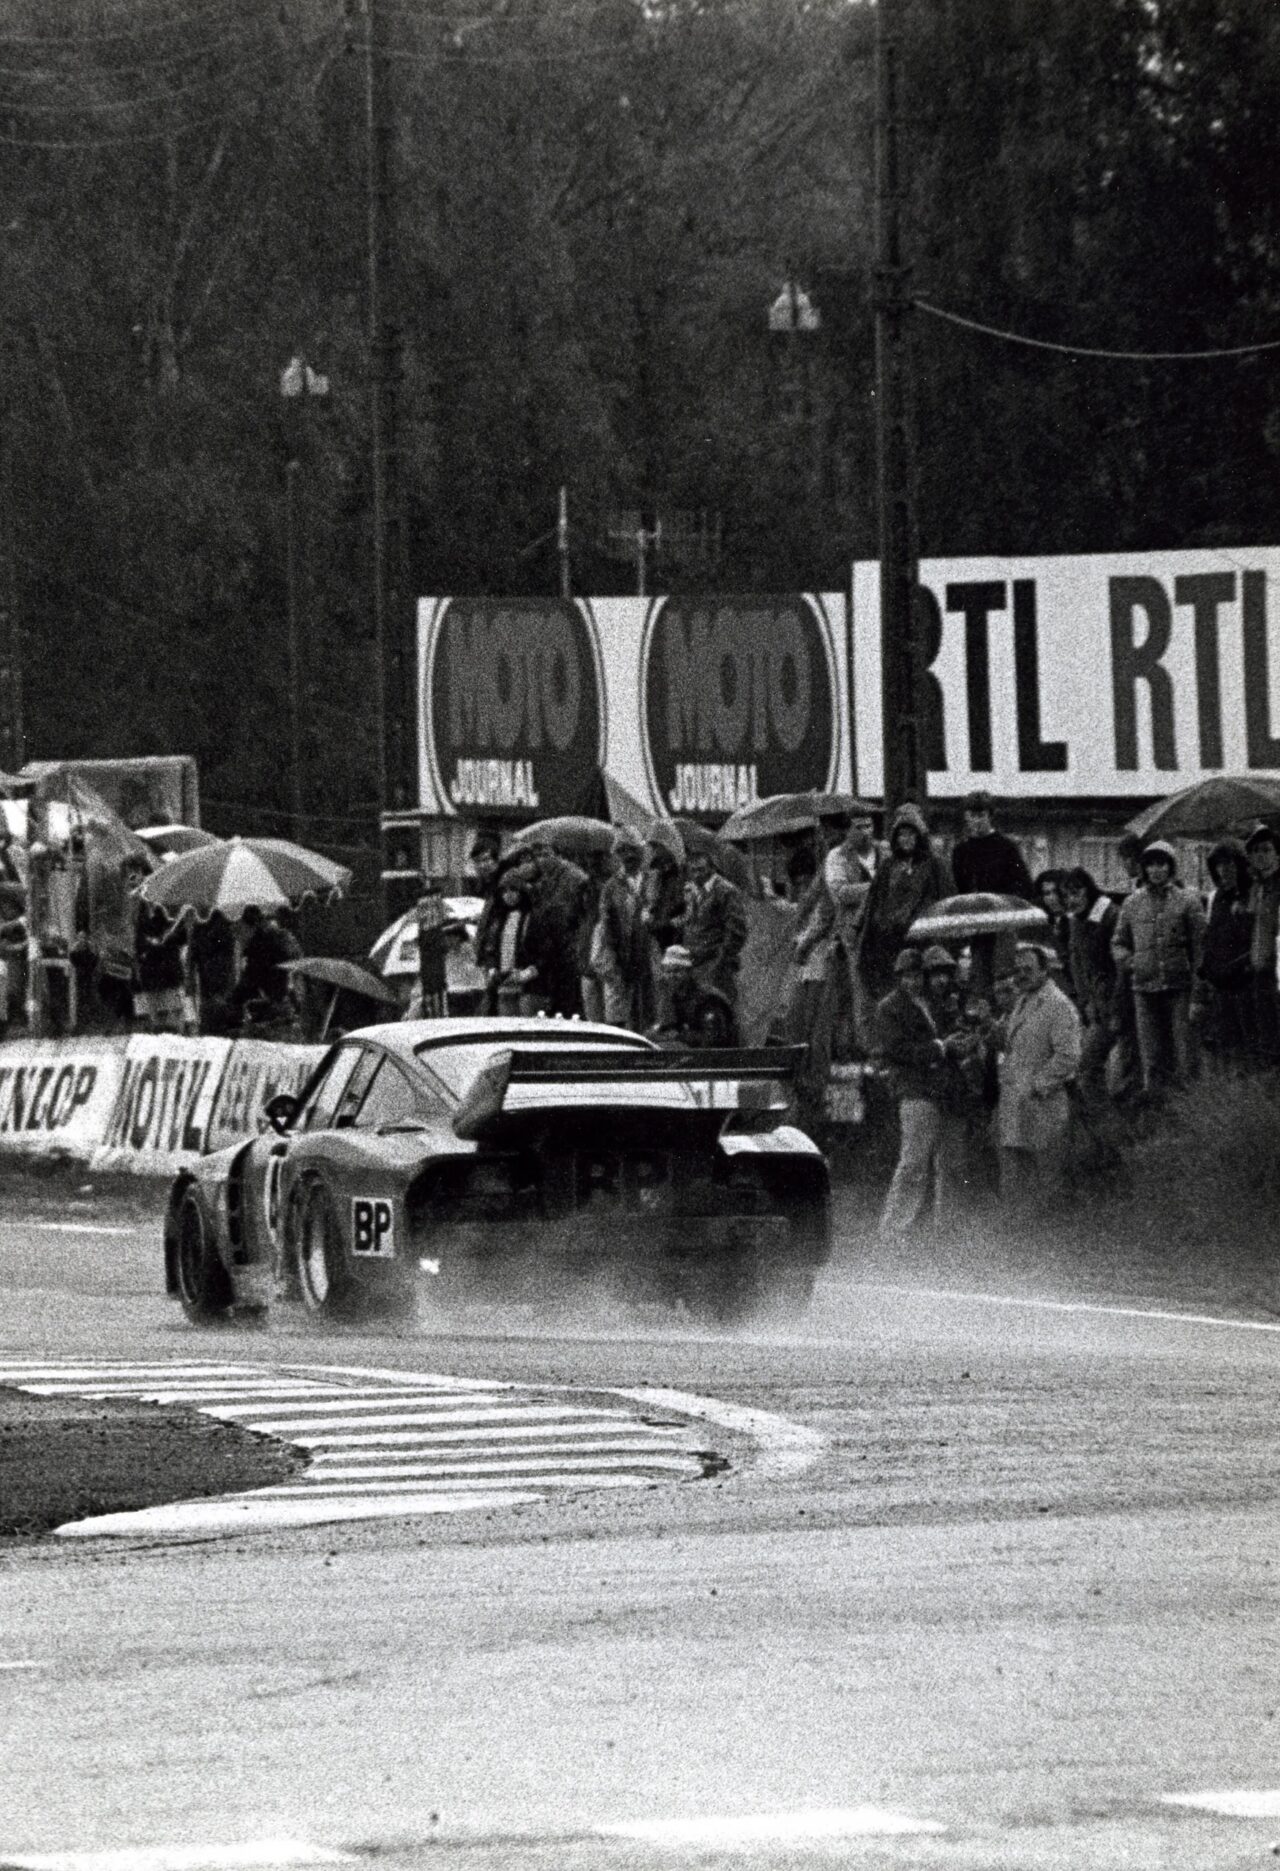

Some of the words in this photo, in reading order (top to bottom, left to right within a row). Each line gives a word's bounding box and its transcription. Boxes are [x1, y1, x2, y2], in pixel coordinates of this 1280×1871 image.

[445, 613, 581, 750] MOTO
[664, 611, 813, 752] MOTO
[1107, 570, 1280, 771] RTL
[451, 758, 540, 807] JOURNAL
[670, 763, 758, 811] JOURNAL
[356, 1203, 392, 1252] BP
